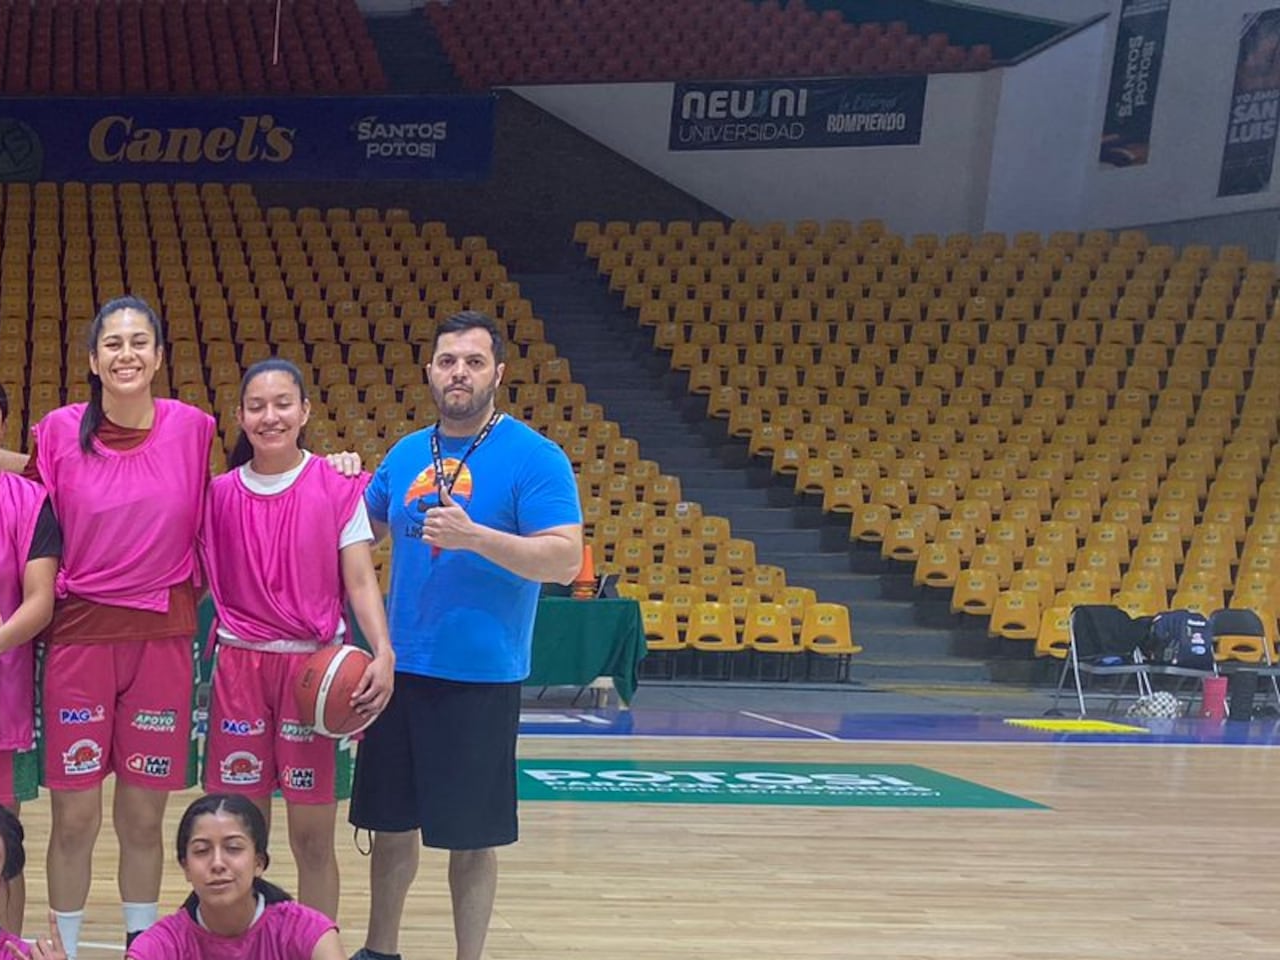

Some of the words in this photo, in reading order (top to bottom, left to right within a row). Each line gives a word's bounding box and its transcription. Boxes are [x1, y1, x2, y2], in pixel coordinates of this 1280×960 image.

[1118, 36, 1144, 117] SANTOS
[1232, 100, 1279, 124] SAN
[357, 120, 447, 140] SANTOS
[679, 122, 805, 142] UNIVERSIDAD
[826, 113, 906, 132] ROMPIENDO
[88, 114, 296, 163] Canel's
[1228, 121, 1276, 144] LUIS
[60, 709, 91, 724] PAG
[136, 713, 175, 725] APOYO
[222, 720, 250, 734] PAG
[144, 764, 169, 776] LUIS
[146, 756, 170, 766] SAN
